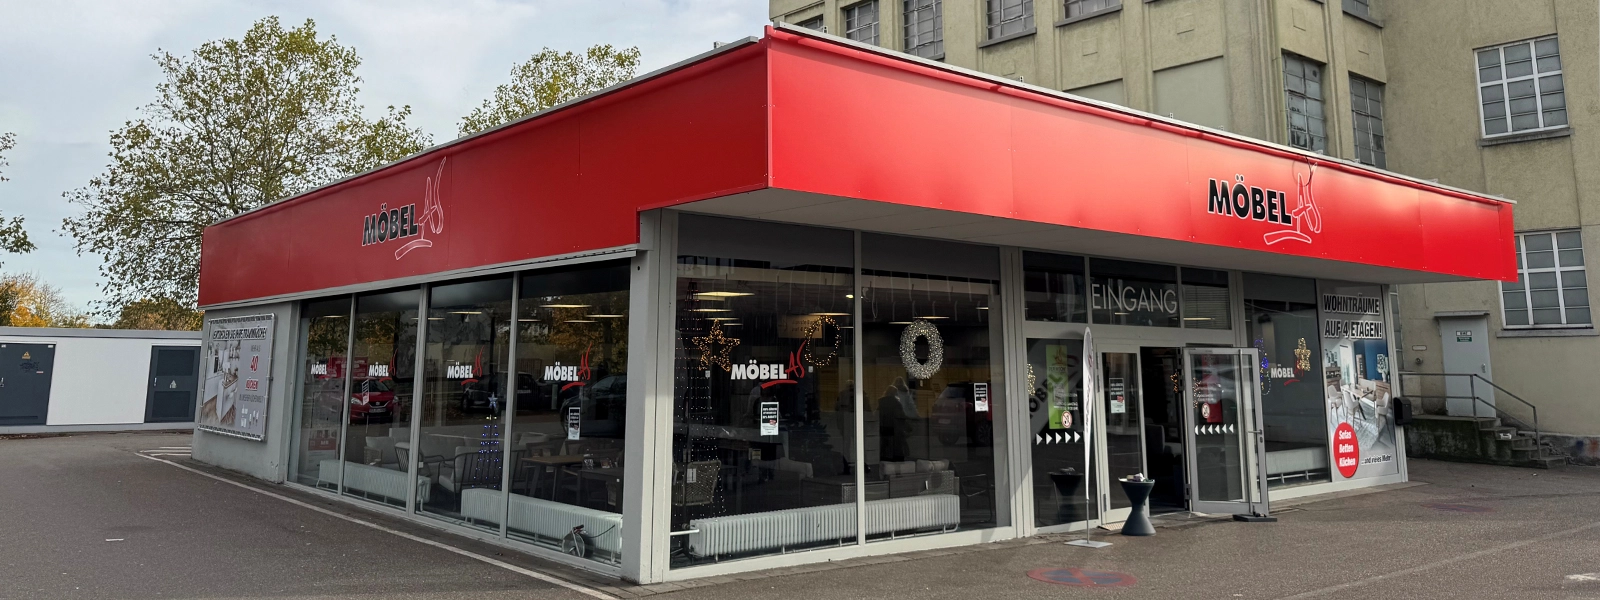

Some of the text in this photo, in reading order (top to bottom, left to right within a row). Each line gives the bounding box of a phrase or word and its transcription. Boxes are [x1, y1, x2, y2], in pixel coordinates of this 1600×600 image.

[1207, 173, 1293, 227] MÖBEL
[361, 202, 418, 247] MÖBEL
[1091, 283, 1178, 314] EINGANG
[1323, 292, 1380, 315] WOHNTRÄUME
[1324, 320, 1383, 339] AUF 4 ETAGEN!
[310, 361, 328, 376] MÖBEL
[368, 362, 389, 377] MÖBEL
[446, 362, 474, 379] MÖBEL
[544, 361, 579, 382] MÖBEL
[730, 359, 788, 380] MÖBEL
[1270, 364, 1295, 379] MÖBEL
[1338, 429, 1352, 440] Sofas
[1338, 443, 1354, 454] Betten
[1338, 456, 1356, 468] Küchen
